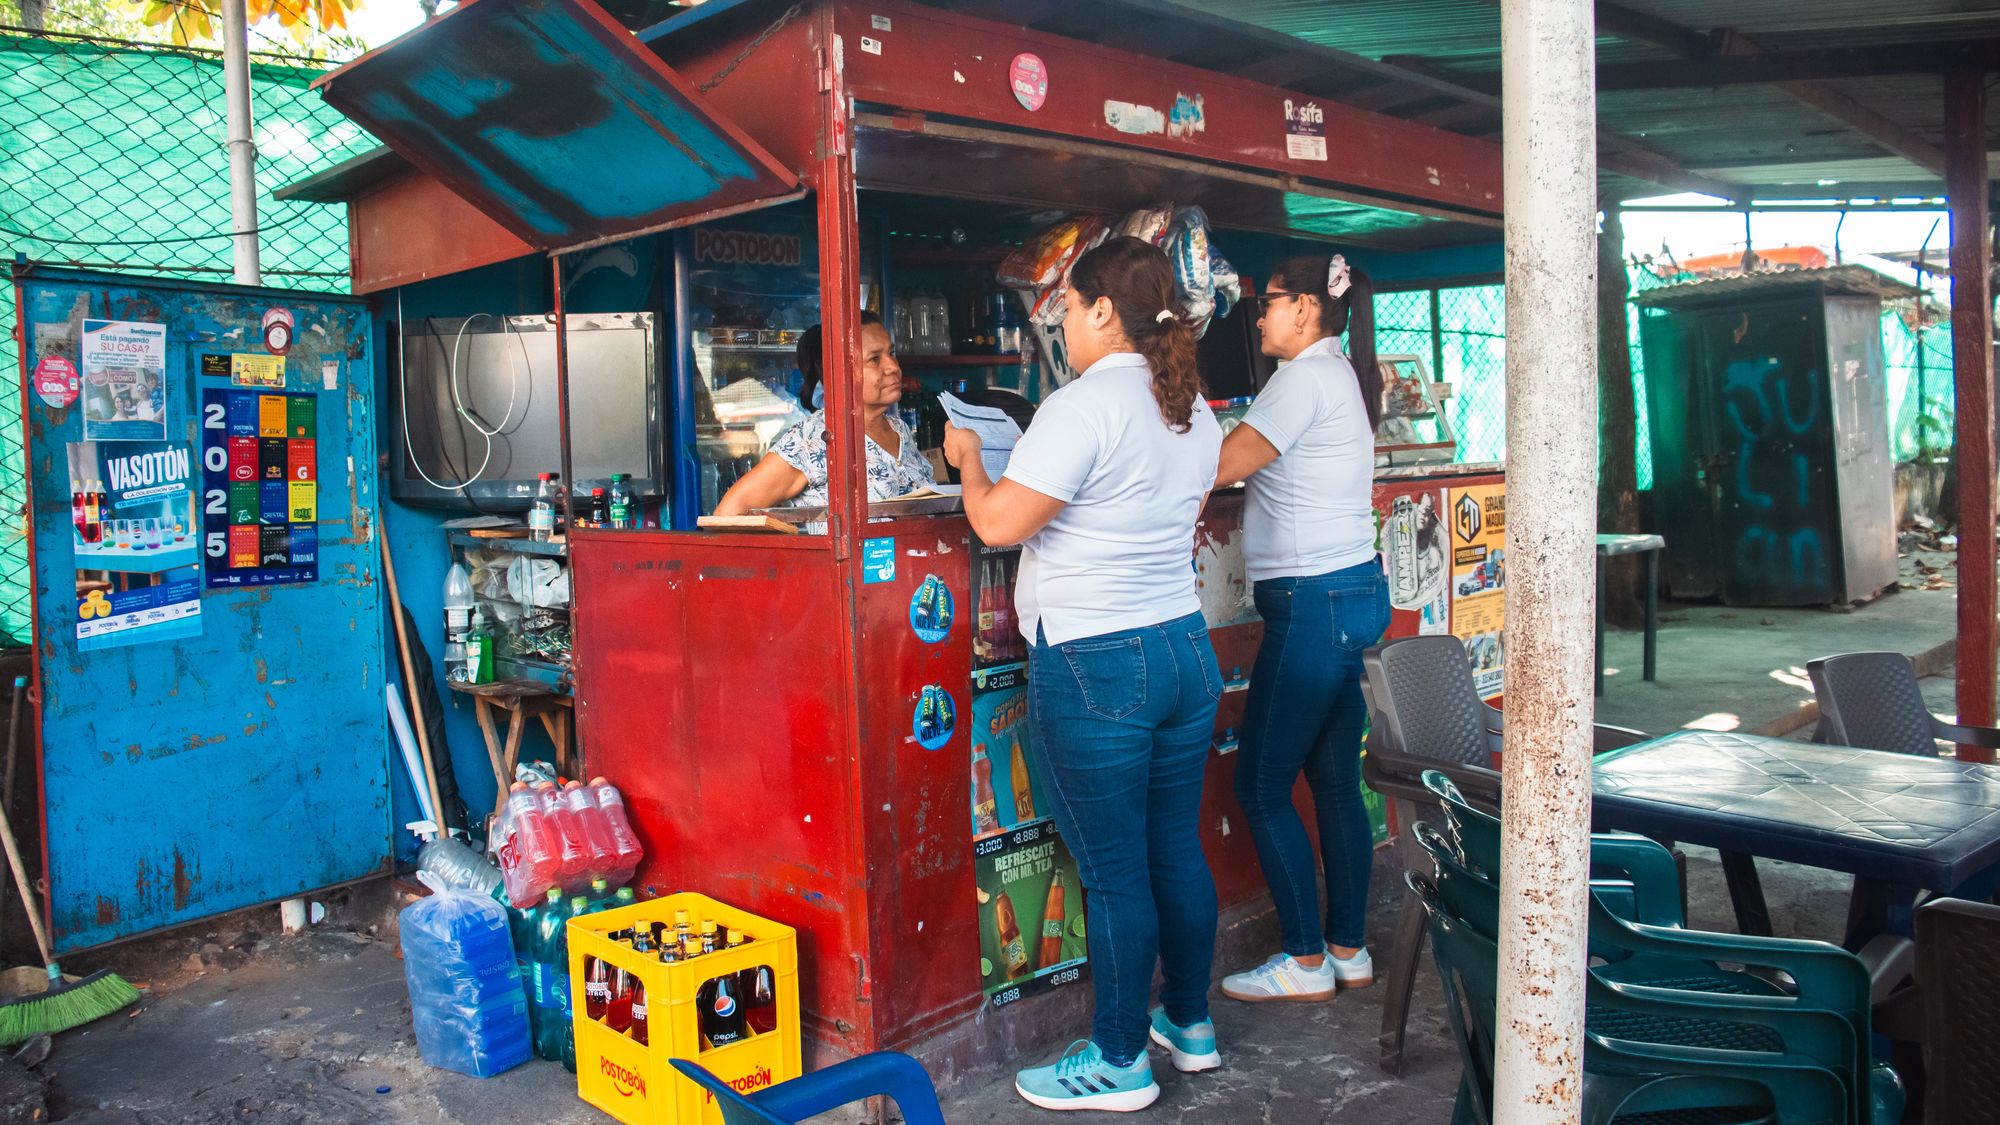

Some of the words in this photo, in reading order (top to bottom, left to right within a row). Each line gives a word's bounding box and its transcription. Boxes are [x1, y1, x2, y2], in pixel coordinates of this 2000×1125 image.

[100, 333, 117, 341] Está
[118, 336, 150, 344] pagando
[100, 342, 114, 351] SU
[117, 343, 150, 353] CASA?
[107, 445, 190, 491] VASOTÓN
[915, 615, 936, 629] NUEVO
[920, 726, 941, 742] NUEVO
[994, 841, 1055, 872] REFRÉSCATE
[1001, 866, 1019, 885] CON
[1019, 863, 1035, 879] MR.
[1035, 857, 1053, 874] TEA
[713, 1030, 738, 1041] pepsi
